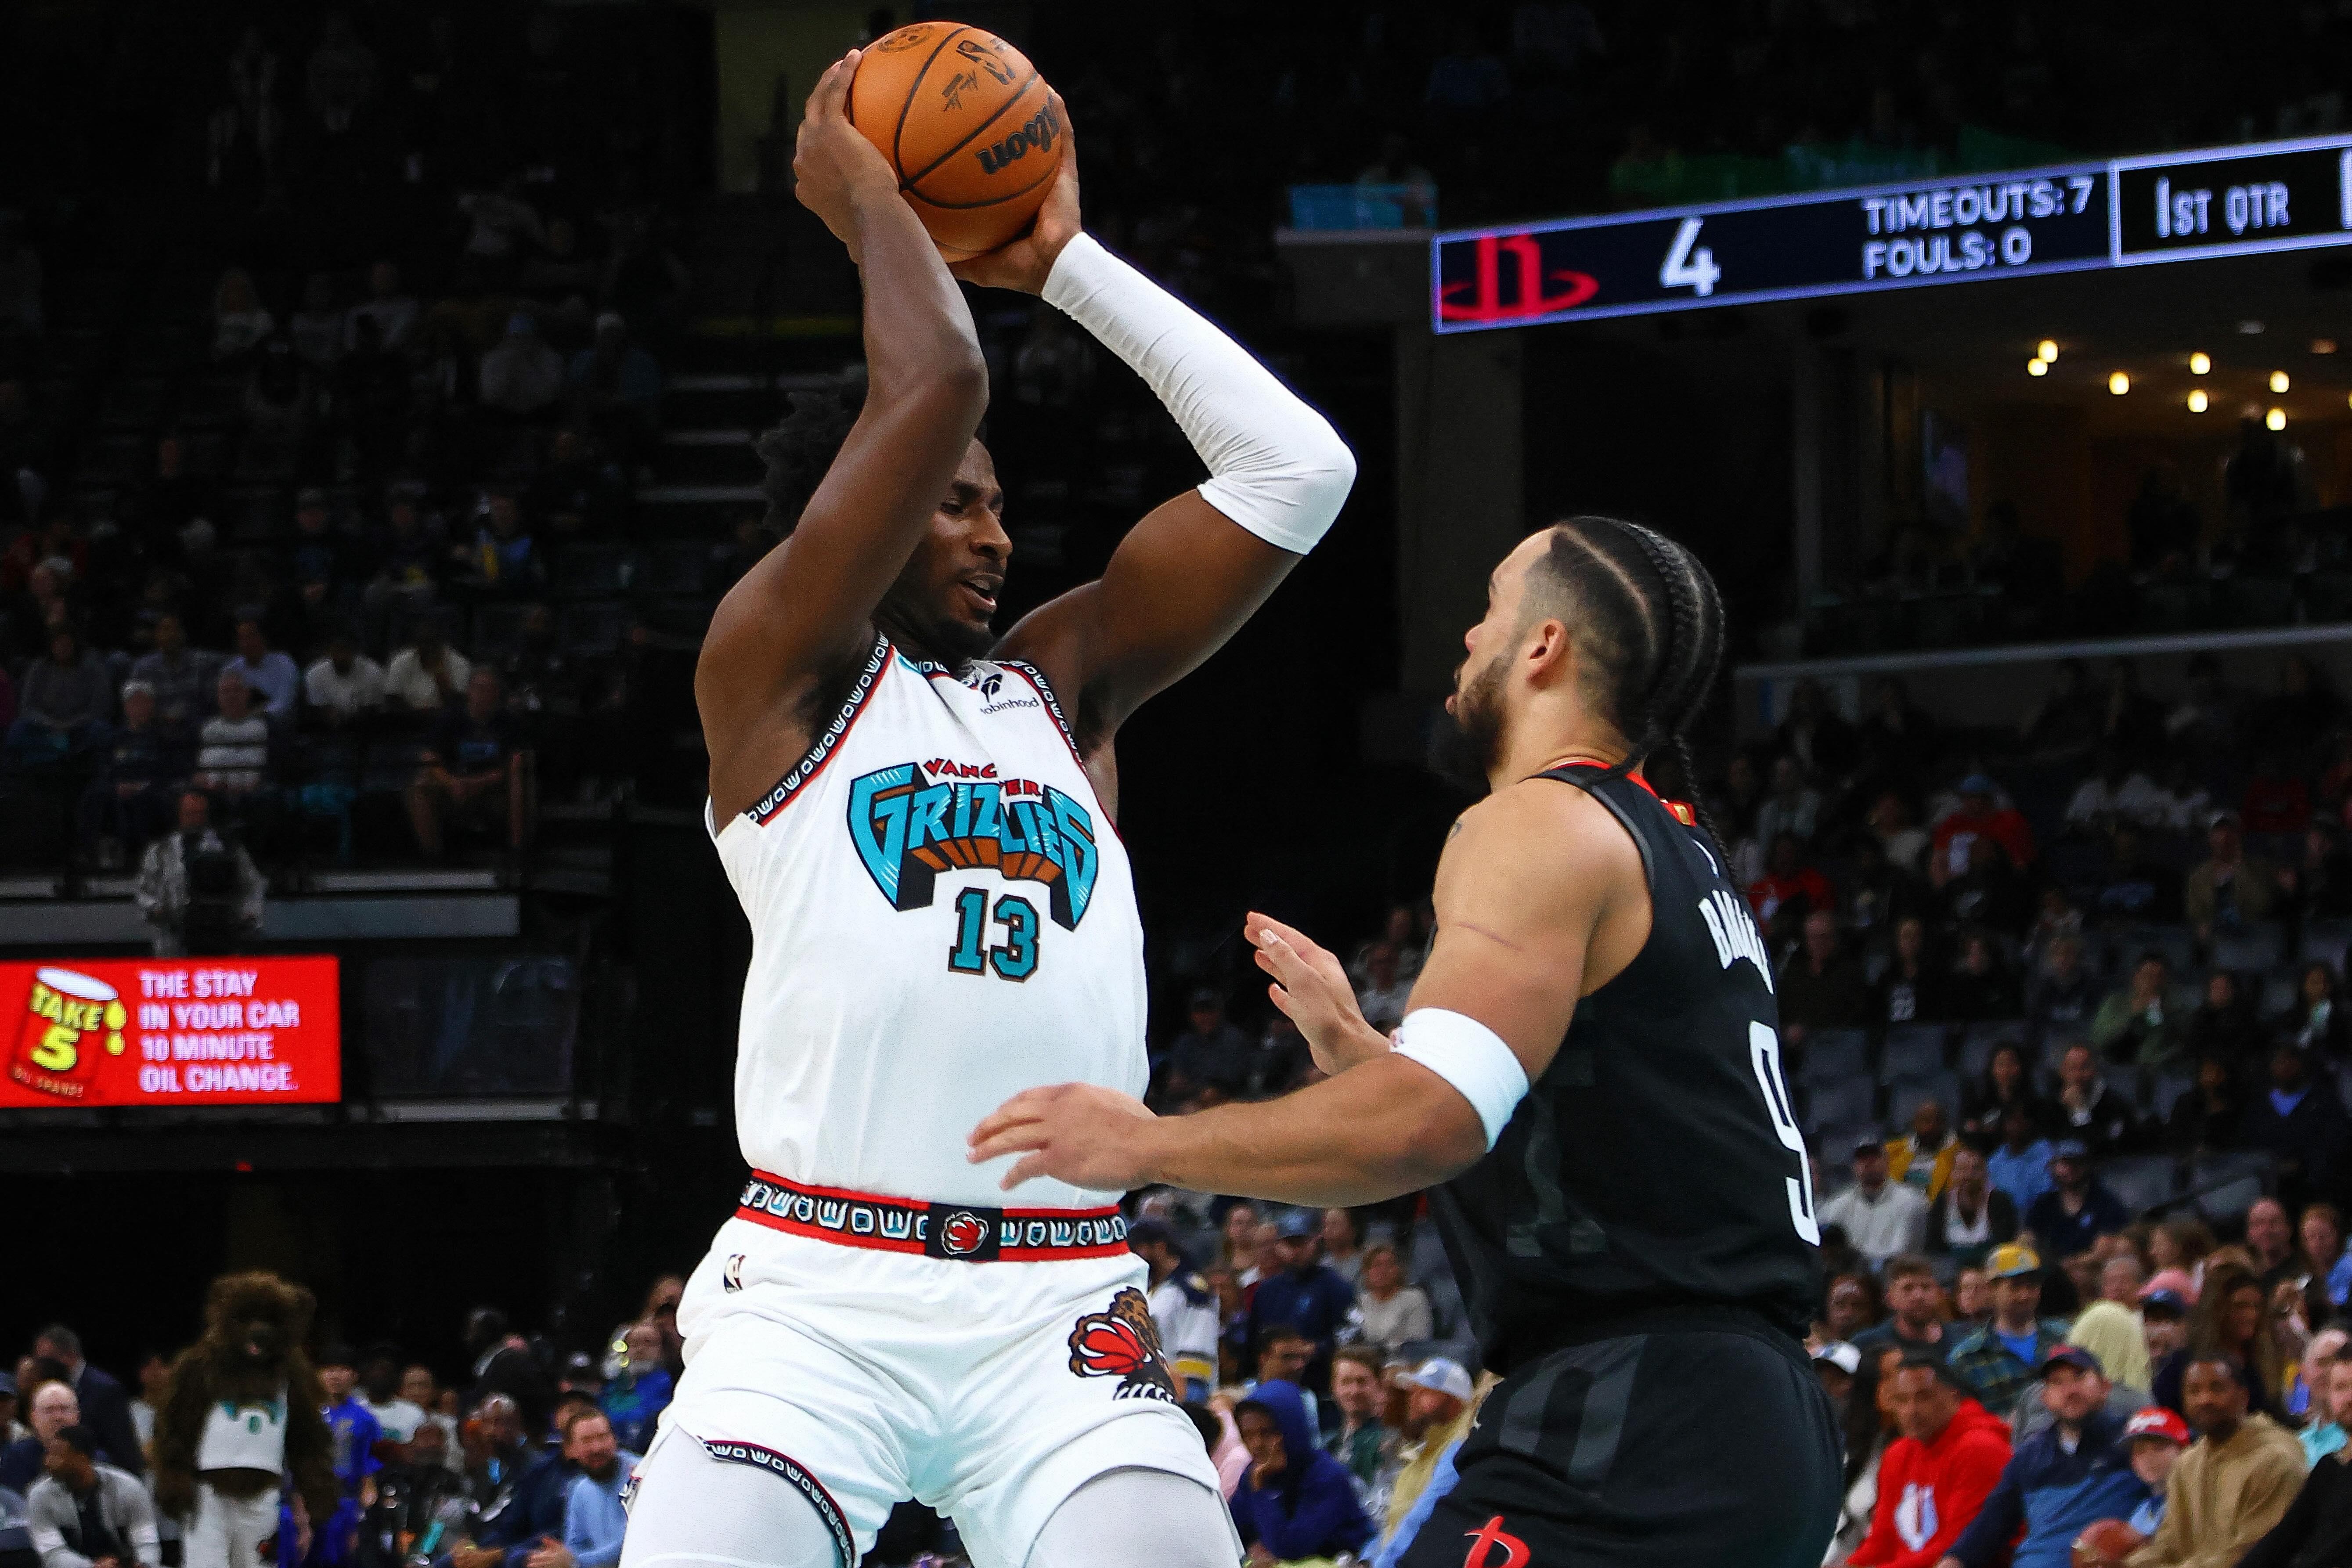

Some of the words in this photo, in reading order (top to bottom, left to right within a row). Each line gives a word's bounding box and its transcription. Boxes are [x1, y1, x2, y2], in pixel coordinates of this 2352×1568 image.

[2225, 180, 2291, 235] QTR
[1659, 215, 1722, 296] 4
[1862, 229, 1995, 280] FOULS:
[1999, 224, 2031, 266] 0
[948, 887, 1040, 983] 13
[29, 982, 104, 1031] TAKE
[140, 970, 189, 998] THE
[193, 970, 258, 998] STAY
[139, 1002, 170, 1030] IN
[173, 1001, 243, 1030] YOUR
[246, 1000, 300, 1029] CAR
[30, 1024, 80, 1071] 5
[141, 1035, 170, 1062] 10
[172, 1034, 275, 1060] MINUTE
[140, 1064, 183, 1092] OIL
